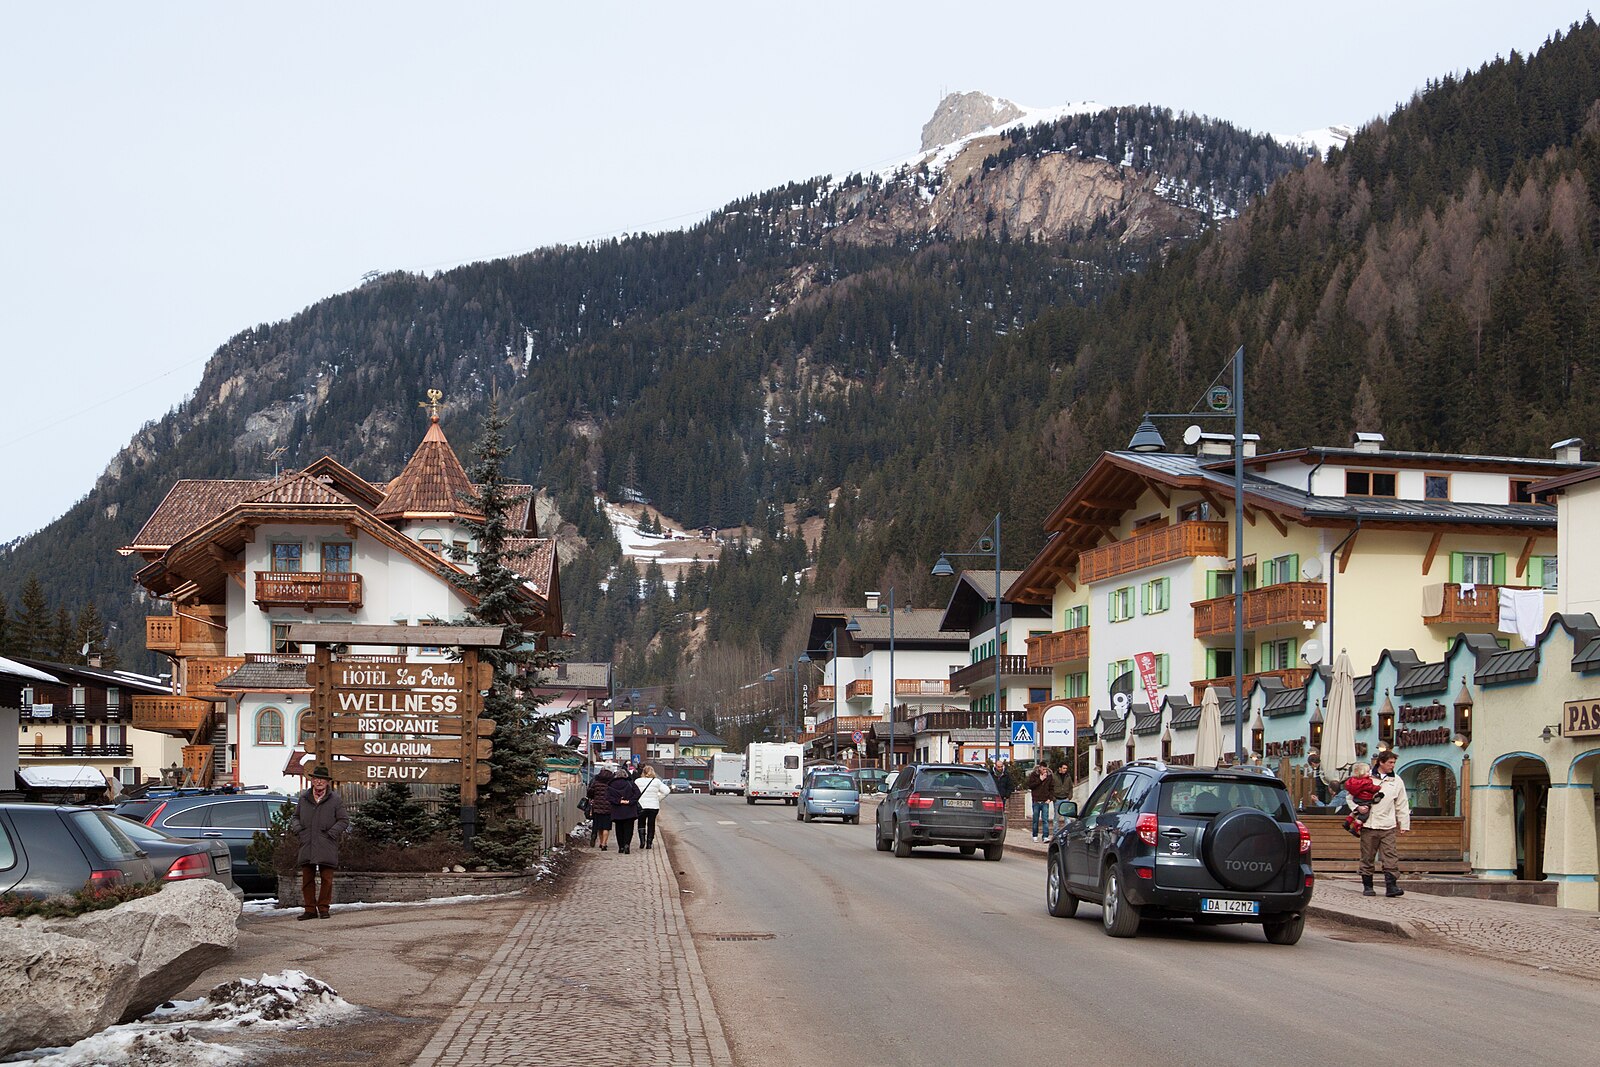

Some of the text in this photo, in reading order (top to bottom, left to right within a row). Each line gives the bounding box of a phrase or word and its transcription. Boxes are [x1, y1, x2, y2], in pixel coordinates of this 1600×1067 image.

[343, 666, 456, 686] HOTEL La Perla
[338, 693, 457, 713] WELLNESS
[1568, 704, 1600, 731] PAS
[358, 718, 439, 733] RISTORANTE
[363, 742, 431, 756] SOLARIUM
[367, 765, 428, 779] BEAUTY
[1224, 860, 1274, 872] TOYOTA
[1208, 900, 1253, 912] DA 142MZ
